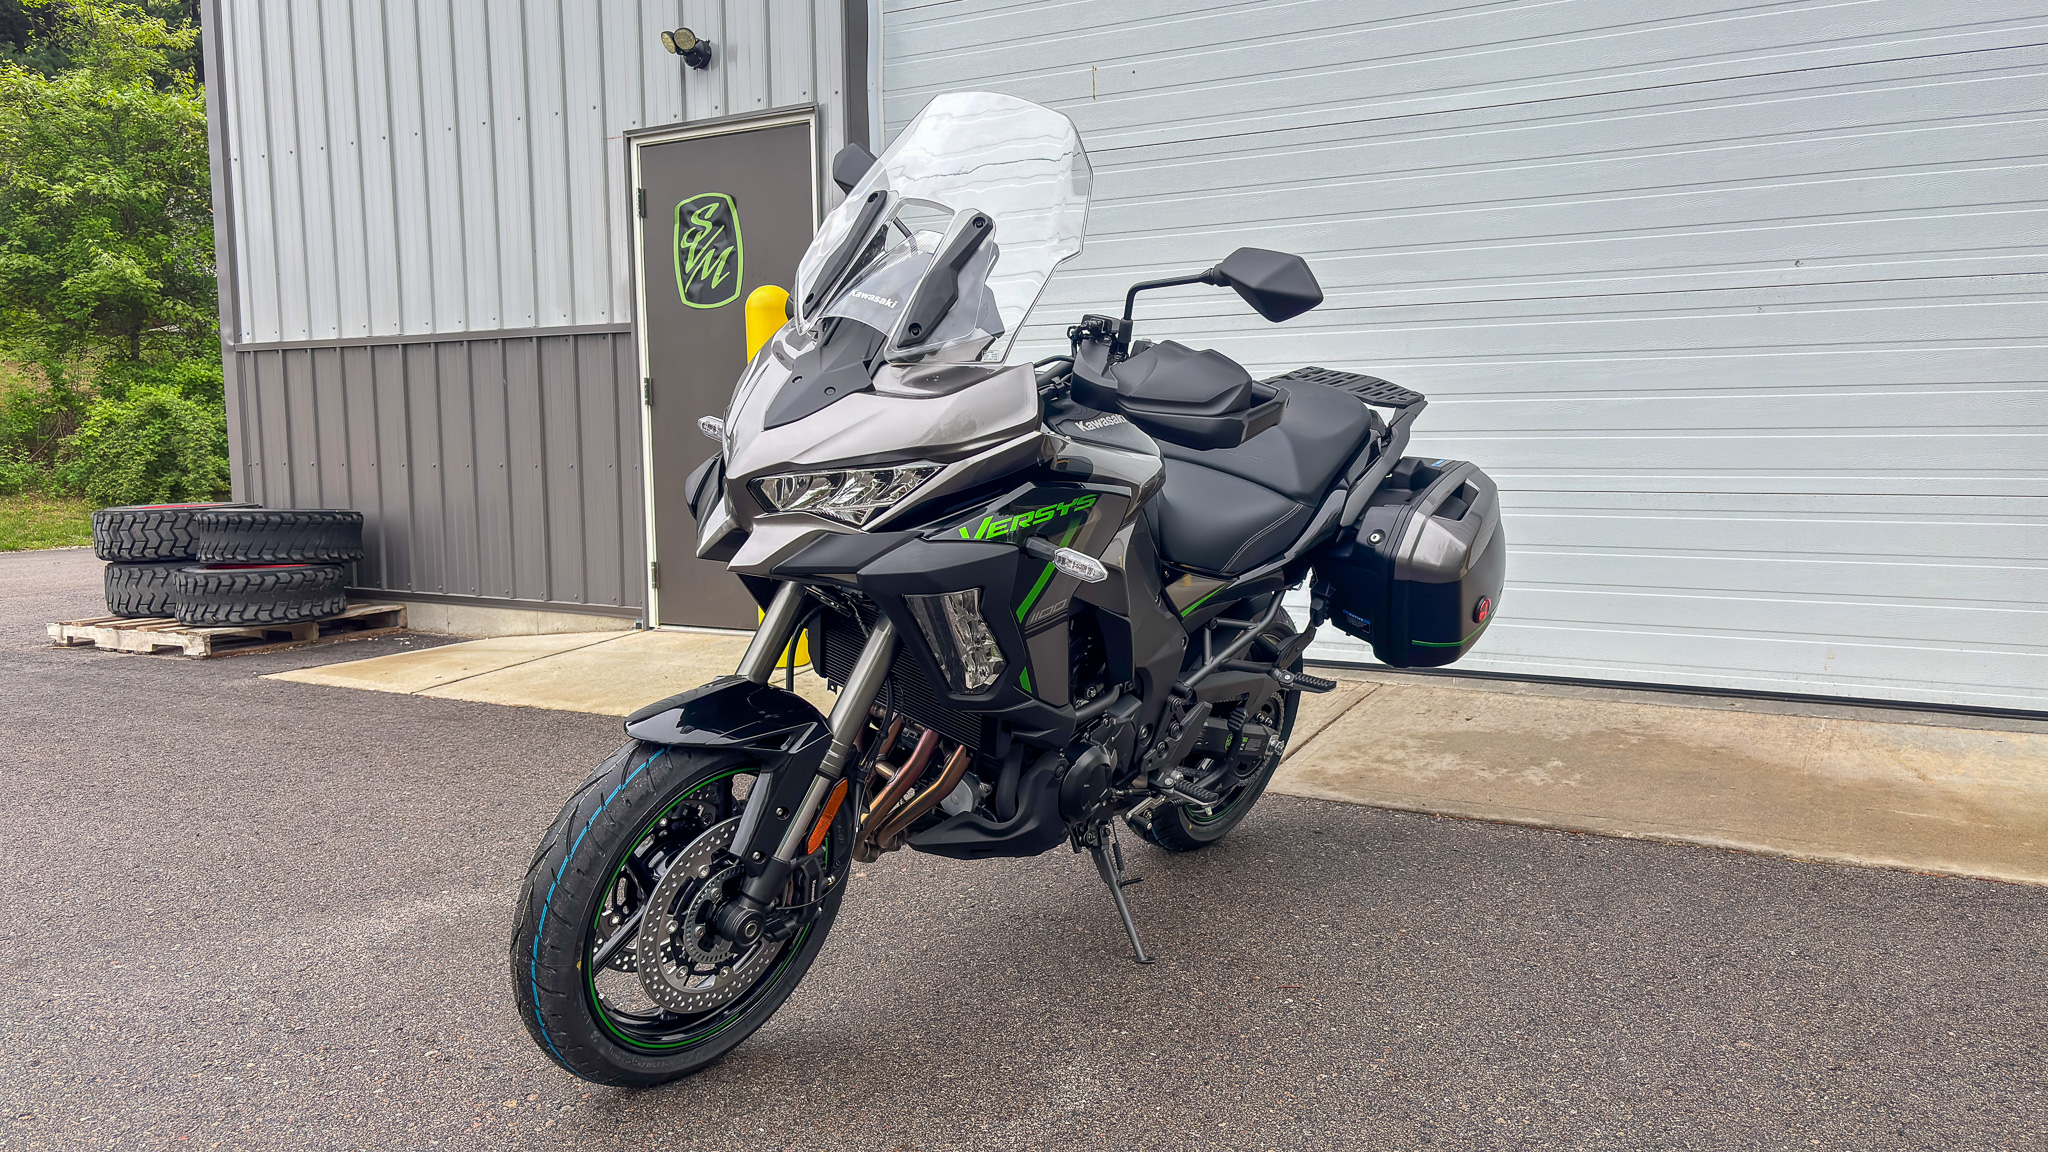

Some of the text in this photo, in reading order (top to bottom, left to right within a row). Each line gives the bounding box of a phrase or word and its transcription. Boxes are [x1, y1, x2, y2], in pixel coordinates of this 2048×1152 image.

[849, 288, 899, 309] Kawasaki
[1074, 413, 1129, 432] Kawasaki
[958, 494, 1098, 540] VERSYS
[1030, 598, 1068, 623] 1100
